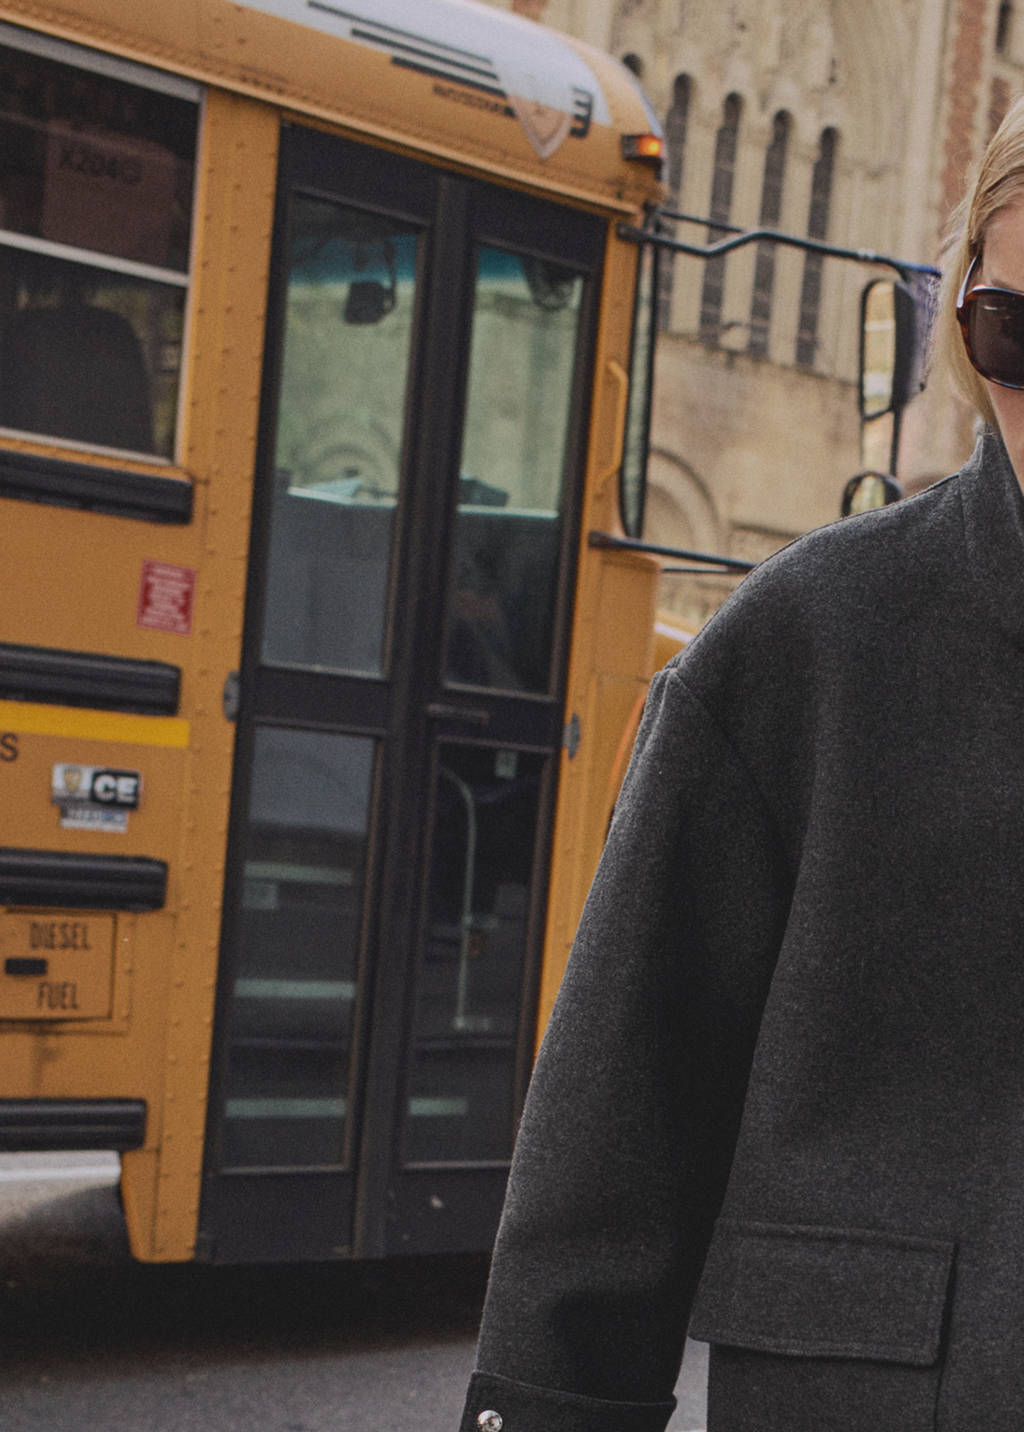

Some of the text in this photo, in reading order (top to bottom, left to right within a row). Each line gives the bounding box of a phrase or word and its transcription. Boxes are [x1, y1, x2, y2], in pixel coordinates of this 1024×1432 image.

[93, 774, 139, 803] CE
[30, 921, 92, 950] DIESEL
[37, 981, 80, 1010] FUEL
